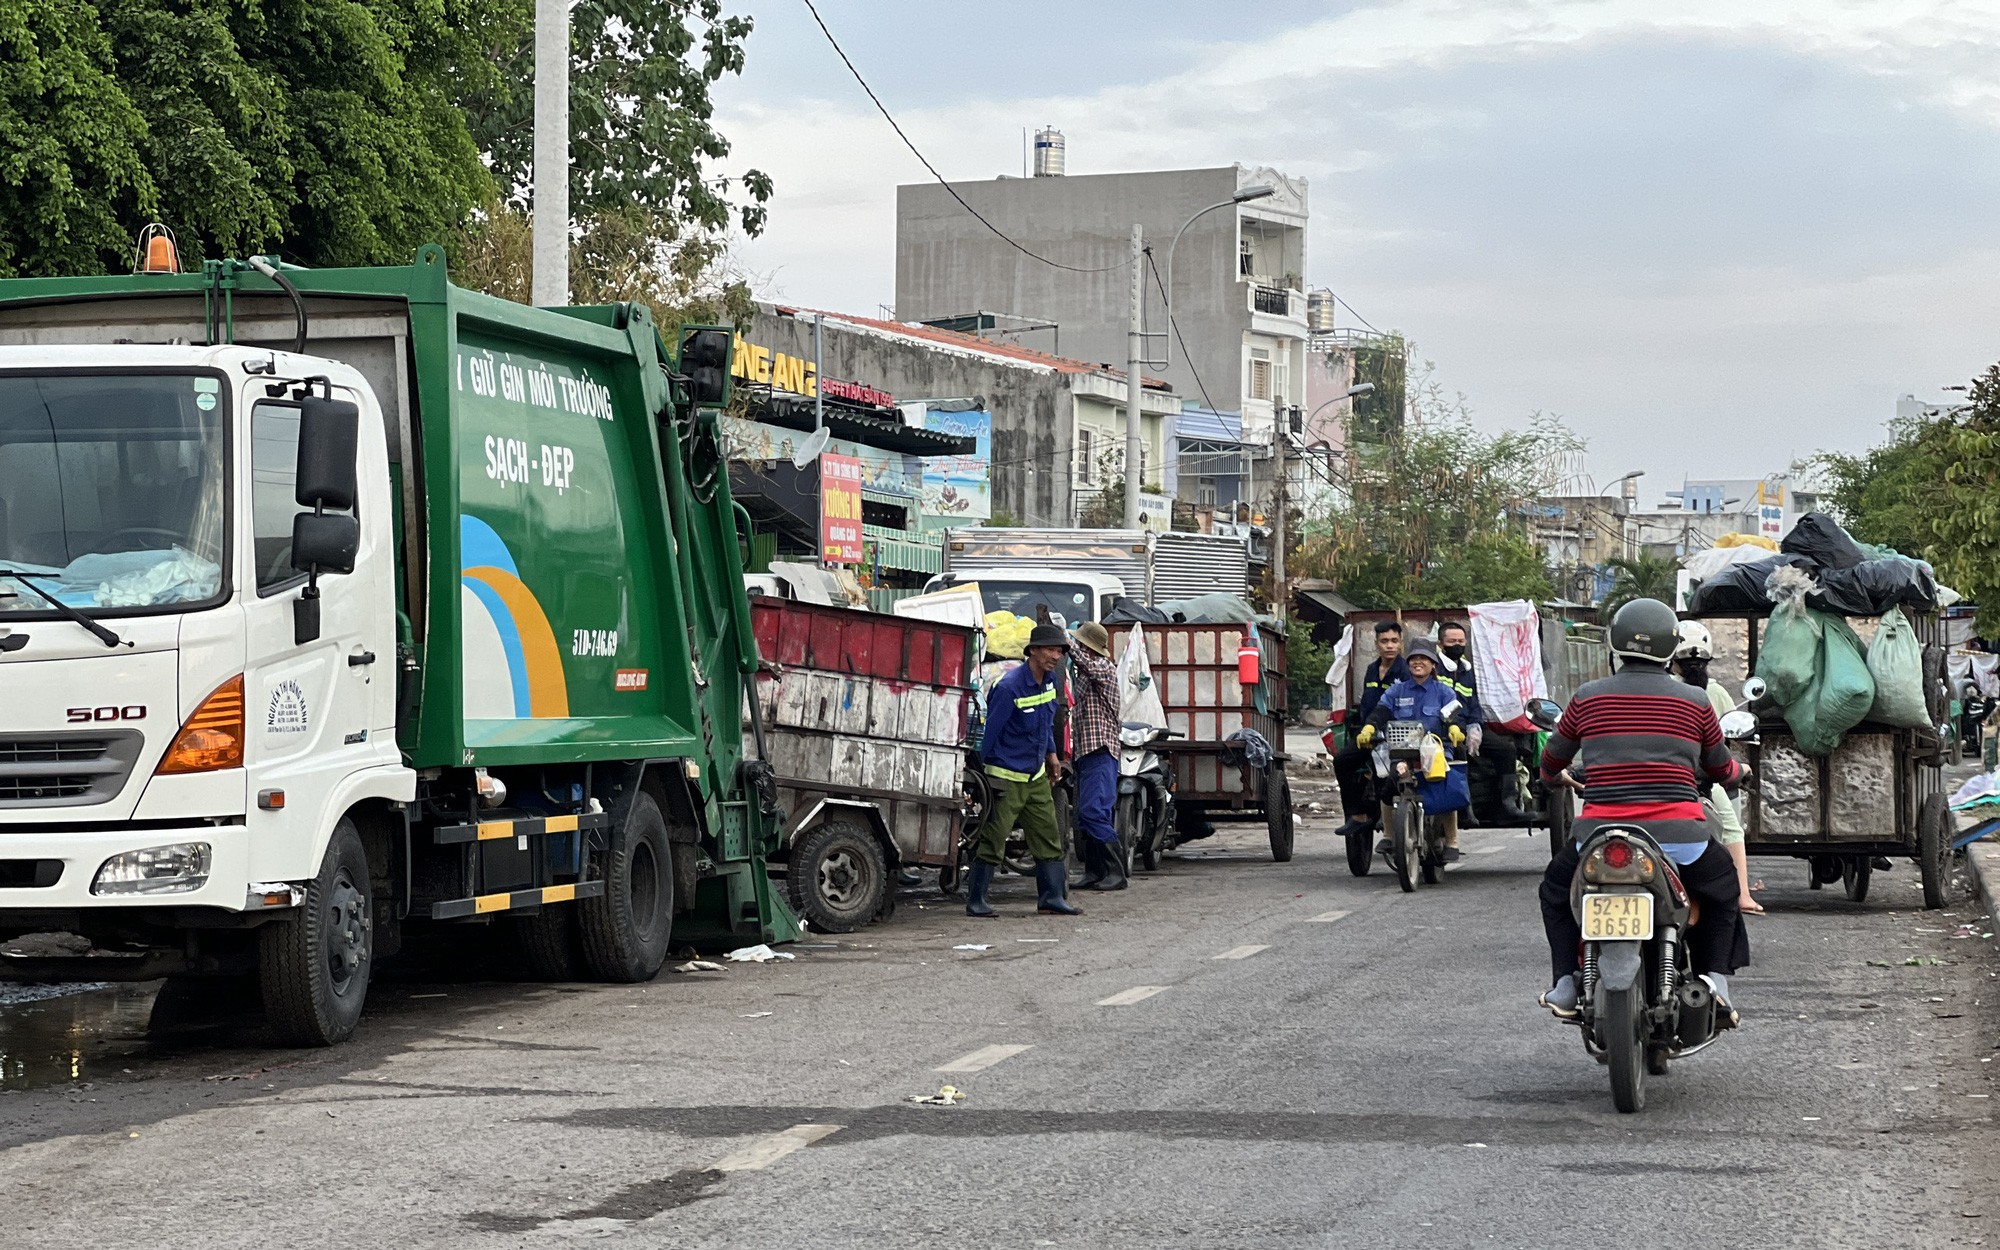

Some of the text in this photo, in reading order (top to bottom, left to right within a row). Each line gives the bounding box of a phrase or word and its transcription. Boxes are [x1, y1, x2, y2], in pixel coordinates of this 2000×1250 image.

[500, 352, 526, 404] GÌN
[528, 363, 557, 409] MÔI
[558, 368, 614, 421] TRƯỜNG
[772, 352, 804, 395] AN
[821, 377, 851, 400] BUFFET
[484, 435, 574, 496] SẠCH - ĐẸP
[825, 481, 860, 520] XƯỞNG IN
[830, 523, 856, 542] QUẢNG CÁO
[572, 628, 618, 657] 51D-746.69
[66, 705, 147, 723] 500
[267, 688, 281, 726] NGUYỄN
[1592, 918, 1641, 936] 3658
